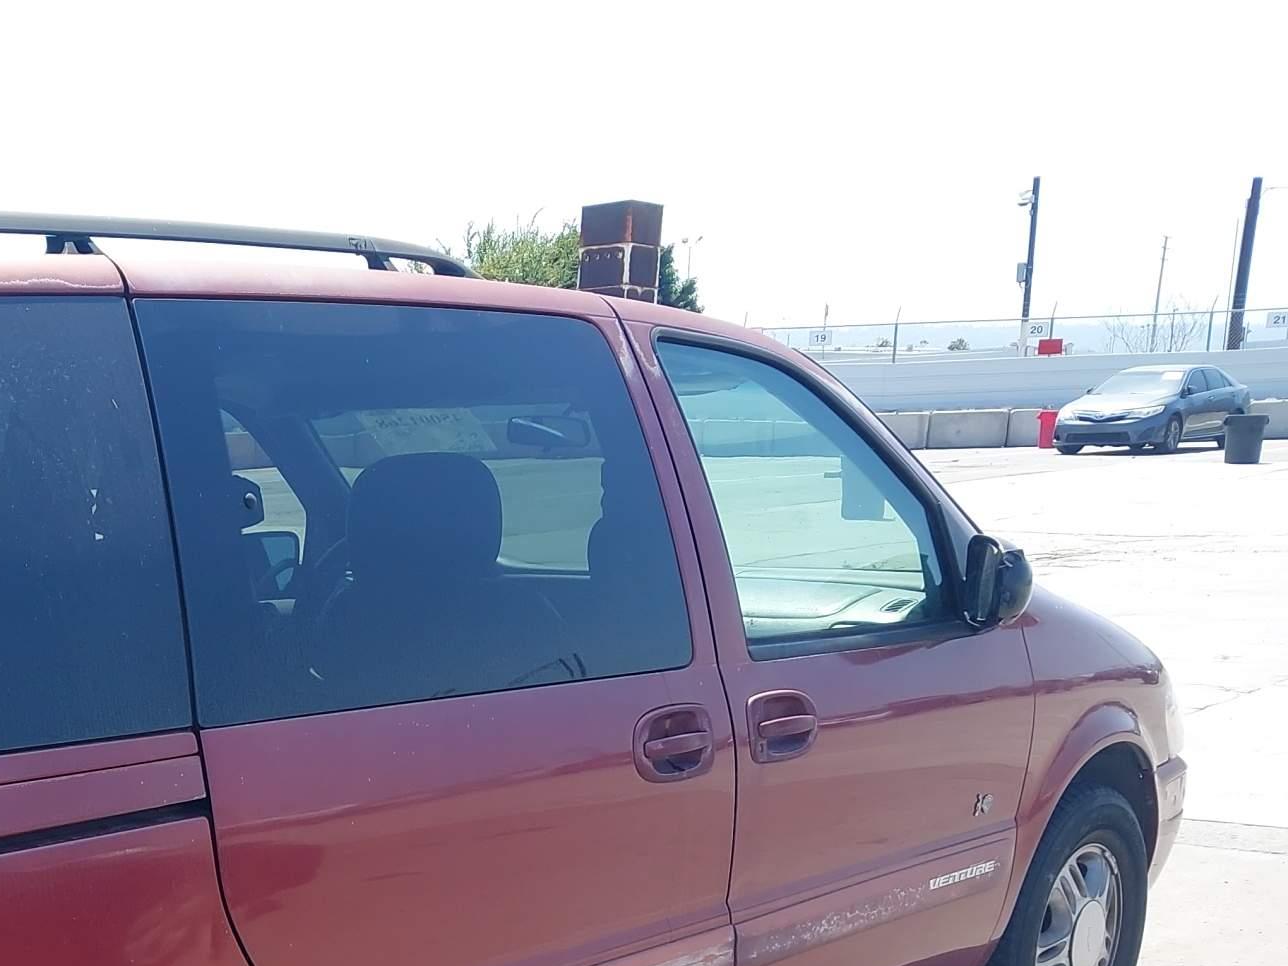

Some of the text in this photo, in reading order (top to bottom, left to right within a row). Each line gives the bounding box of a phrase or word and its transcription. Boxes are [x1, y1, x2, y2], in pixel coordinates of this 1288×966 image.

[1273, 315, 1286, 325] 21
[1030, 325, 1043, 334] 20
[814, 334, 827, 343] 19
[929, 860, 996, 890] VENTURE
